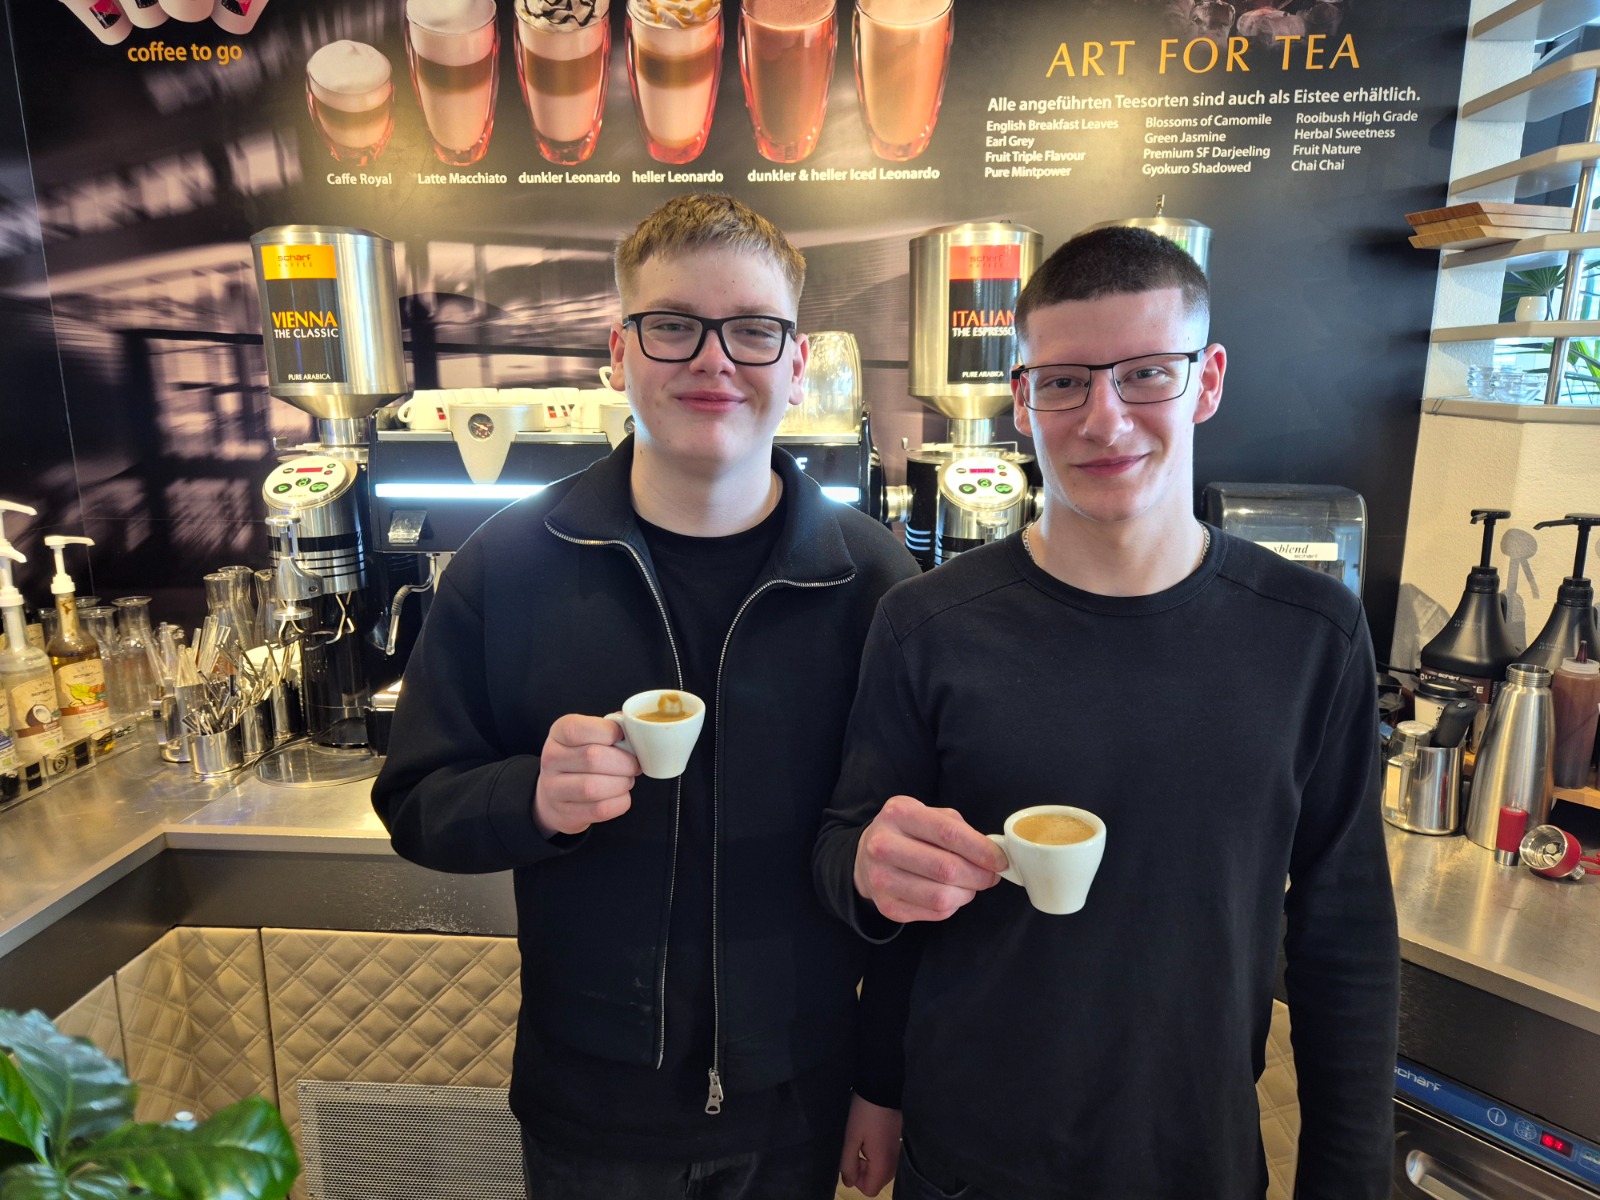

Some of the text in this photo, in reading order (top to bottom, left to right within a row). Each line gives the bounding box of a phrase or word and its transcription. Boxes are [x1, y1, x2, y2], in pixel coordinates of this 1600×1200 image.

[128, 41, 243, 65] coffee to go
[1046, 34, 1359, 77] ART FOR TEA
[988, 86, 1421, 114] Alle angeführten Teesorten sind auch als Eistee erhältlich.
[1145, 114, 1272, 128] Blossoms of Camomile
[1296, 110, 1419, 125] Rooibush High Grade
[987, 118, 1119, 134] English Breakfast Leaves
[1144, 131, 1226, 144] Green Jasmine
[1294, 127, 1395, 140] Herbal Sweetness
[986, 135, 1035, 149] Earl Grey
[1143, 146, 1271, 160] Premium SF Darjeeling
[1293, 143, 1361, 156] Fruit Nature
[985, 150, 1086, 164] Fruit Triple Flavour
[985, 165, 1072, 179] Pure Mintpower
[1142, 162, 1252, 177] Gyokuro Shadowed
[1291, 159, 1345, 172] Chai Chai
[327, 173, 392, 187] Caffe Royal
[418, 172, 507, 184] Latte Macchiato
[518, 171, 620, 184] dunkler Leonardo
[632, 170, 724, 183] heller Leonardo
[747, 167, 940, 182] dunkler & heller Iced Leonardo
[272, 311, 338, 329] VIENNA
[274, 328, 339, 339] THE CLASSIC
[952, 326, 1016, 337] THE ESPRESSO
[288, 373, 303, 381] PURE
